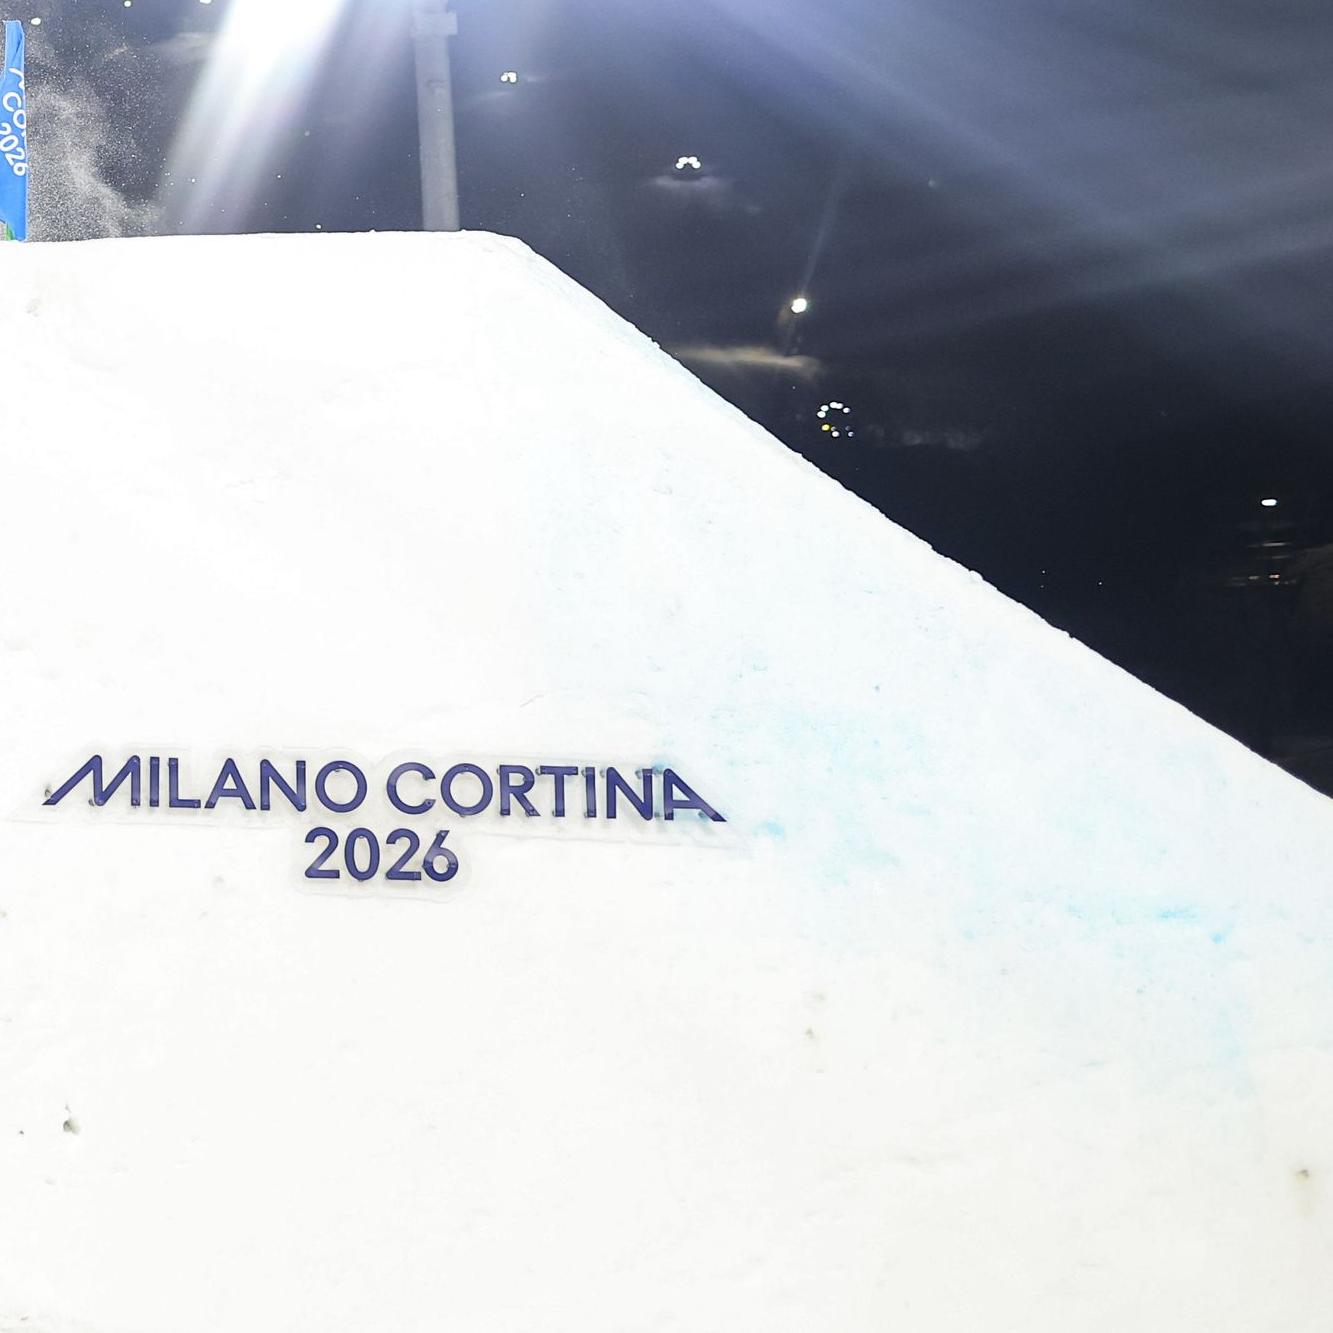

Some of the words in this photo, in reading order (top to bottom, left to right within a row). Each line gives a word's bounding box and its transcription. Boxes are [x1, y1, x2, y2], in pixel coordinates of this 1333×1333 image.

[42, 754, 368, 813] MILANO
[386, 762, 727, 822] CORTINA
[304, 826, 459, 882] 2026
